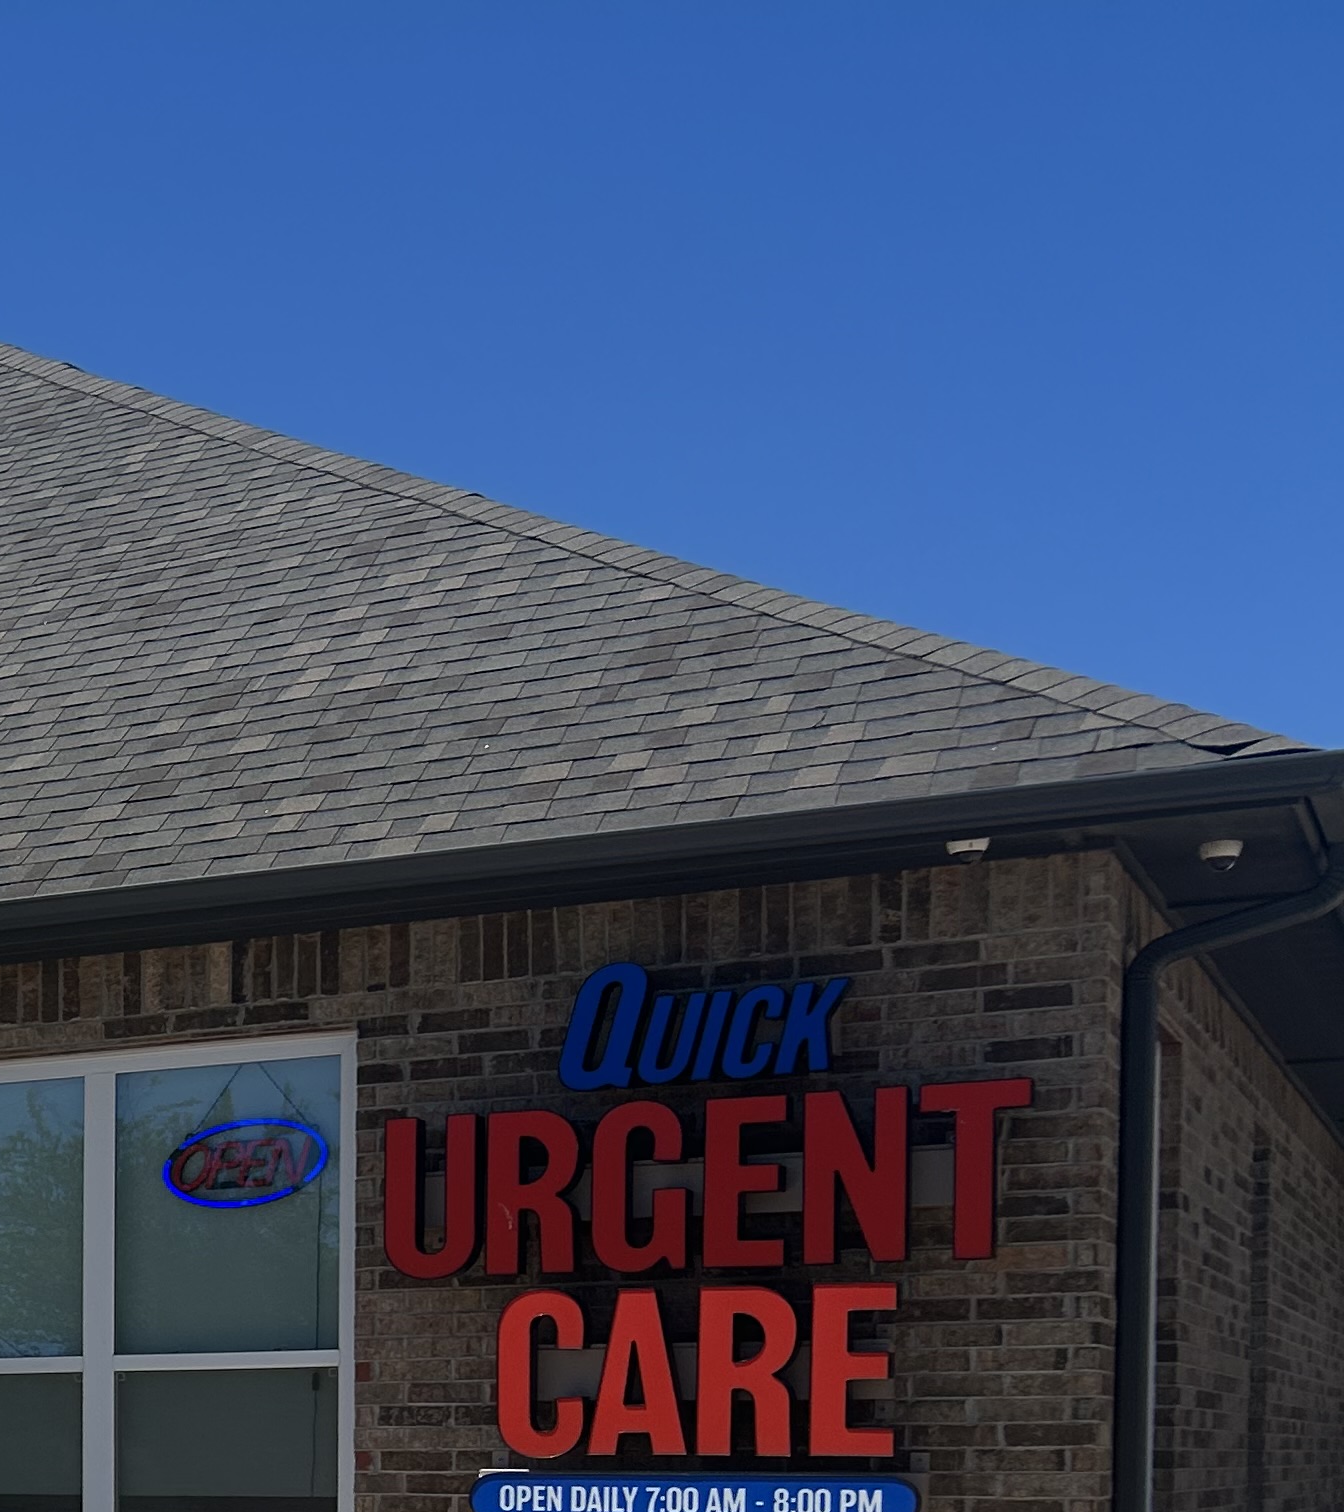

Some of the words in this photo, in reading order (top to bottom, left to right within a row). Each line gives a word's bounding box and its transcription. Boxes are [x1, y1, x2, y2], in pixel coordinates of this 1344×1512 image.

[172, 1136, 312, 1192] OPEN
[383, 1078, 1033, 1280] URGENT
[497, 1282, 898, 1459] CARE
[498, 1484, 563, 1512] OPEN
